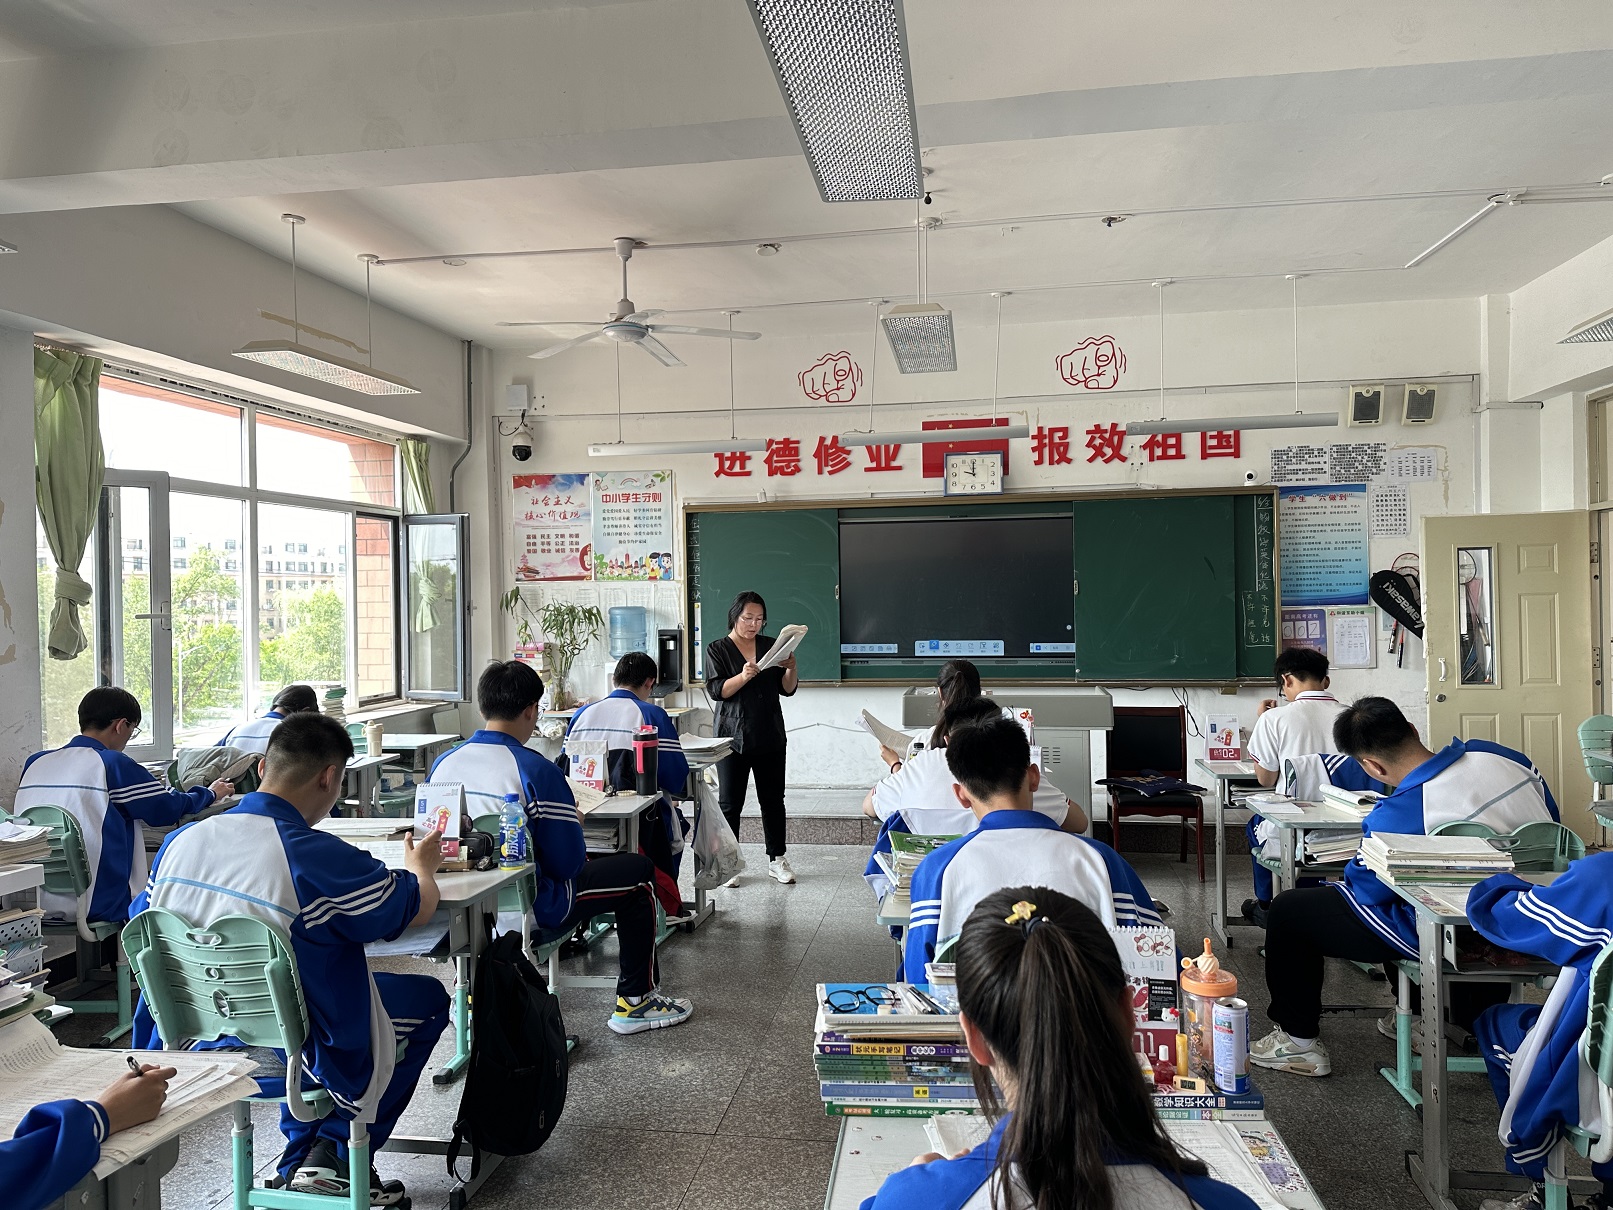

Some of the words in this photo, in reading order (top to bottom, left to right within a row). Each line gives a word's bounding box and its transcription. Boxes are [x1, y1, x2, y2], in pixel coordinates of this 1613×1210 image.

[714, 436, 902, 478] 进德修业
[1031, 422, 1241, 466] 报效祖国
[530, 495, 574, 506] 社会主义
[602, 492, 662, 503] 中小学生守则
[525, 510, 580, 522] 核心价值观
[1379, 582, 1425, 628] Kawasaki
[1154, 1097, 1215, 1107] 数学知识大全
